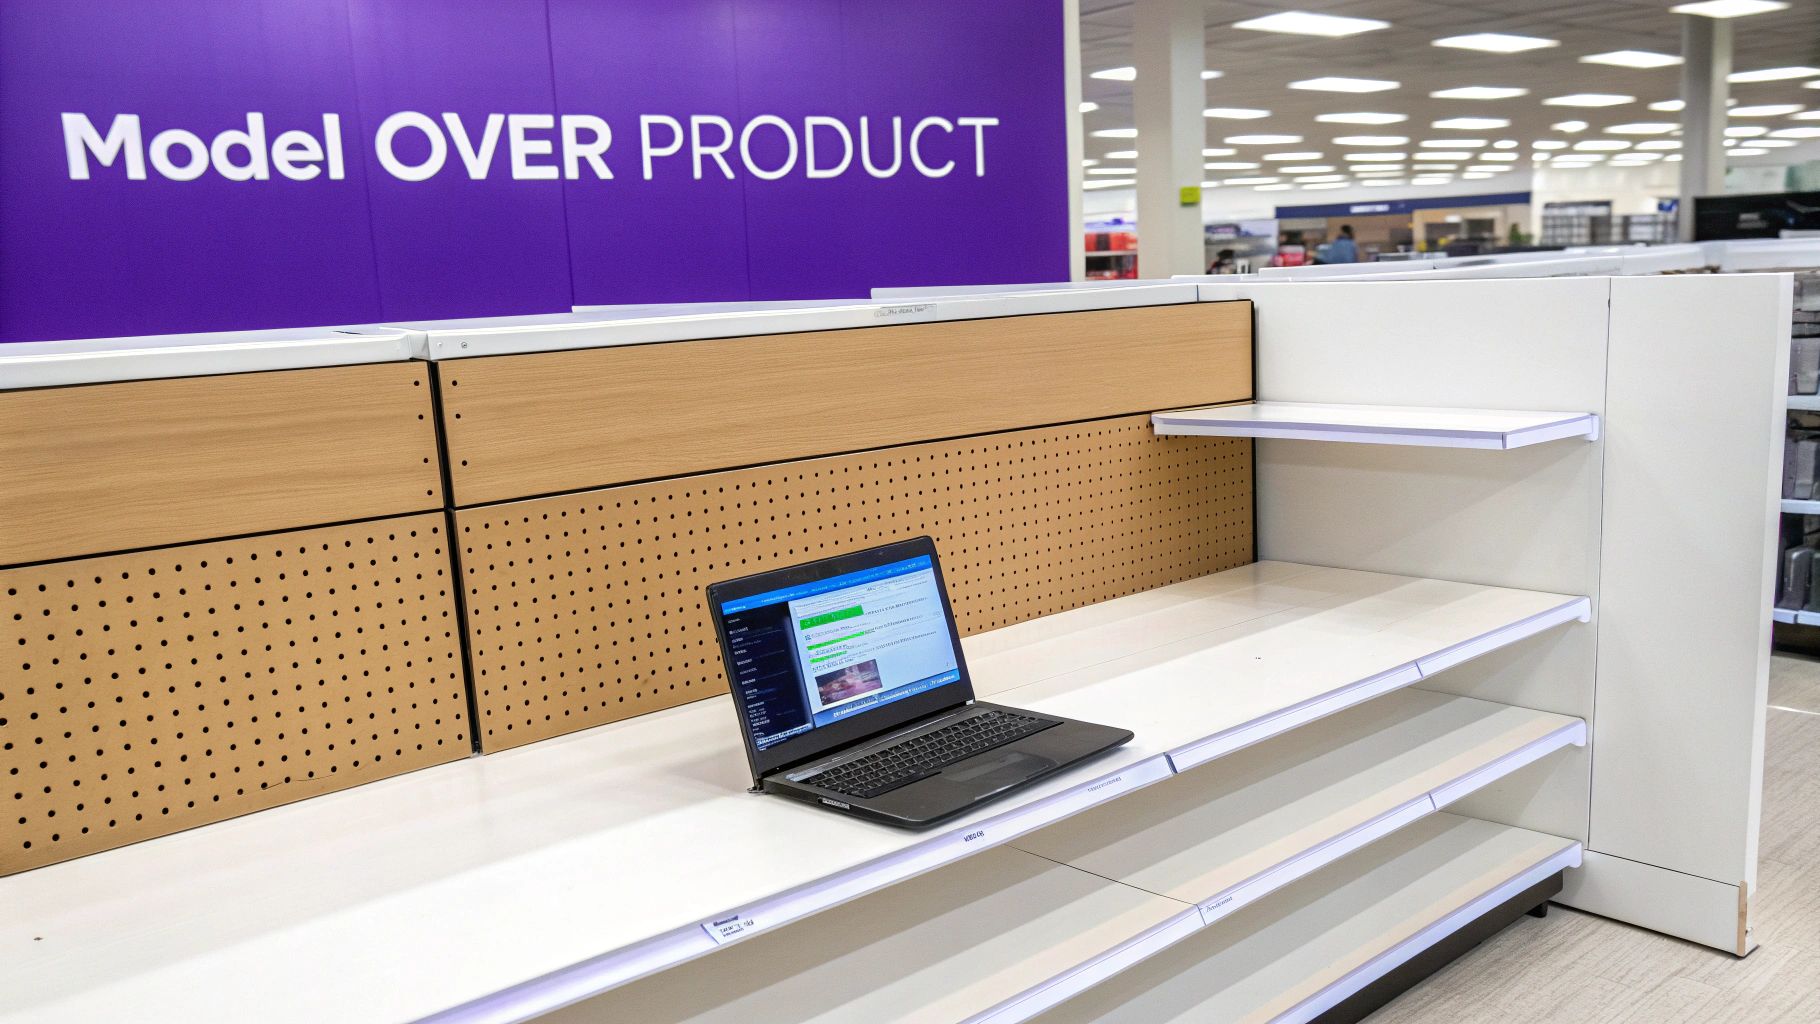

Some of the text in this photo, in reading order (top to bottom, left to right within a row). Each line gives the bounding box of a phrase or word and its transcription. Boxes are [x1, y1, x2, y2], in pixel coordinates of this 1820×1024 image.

[61, 110, 999, 182] Model OVER PRODUCT
